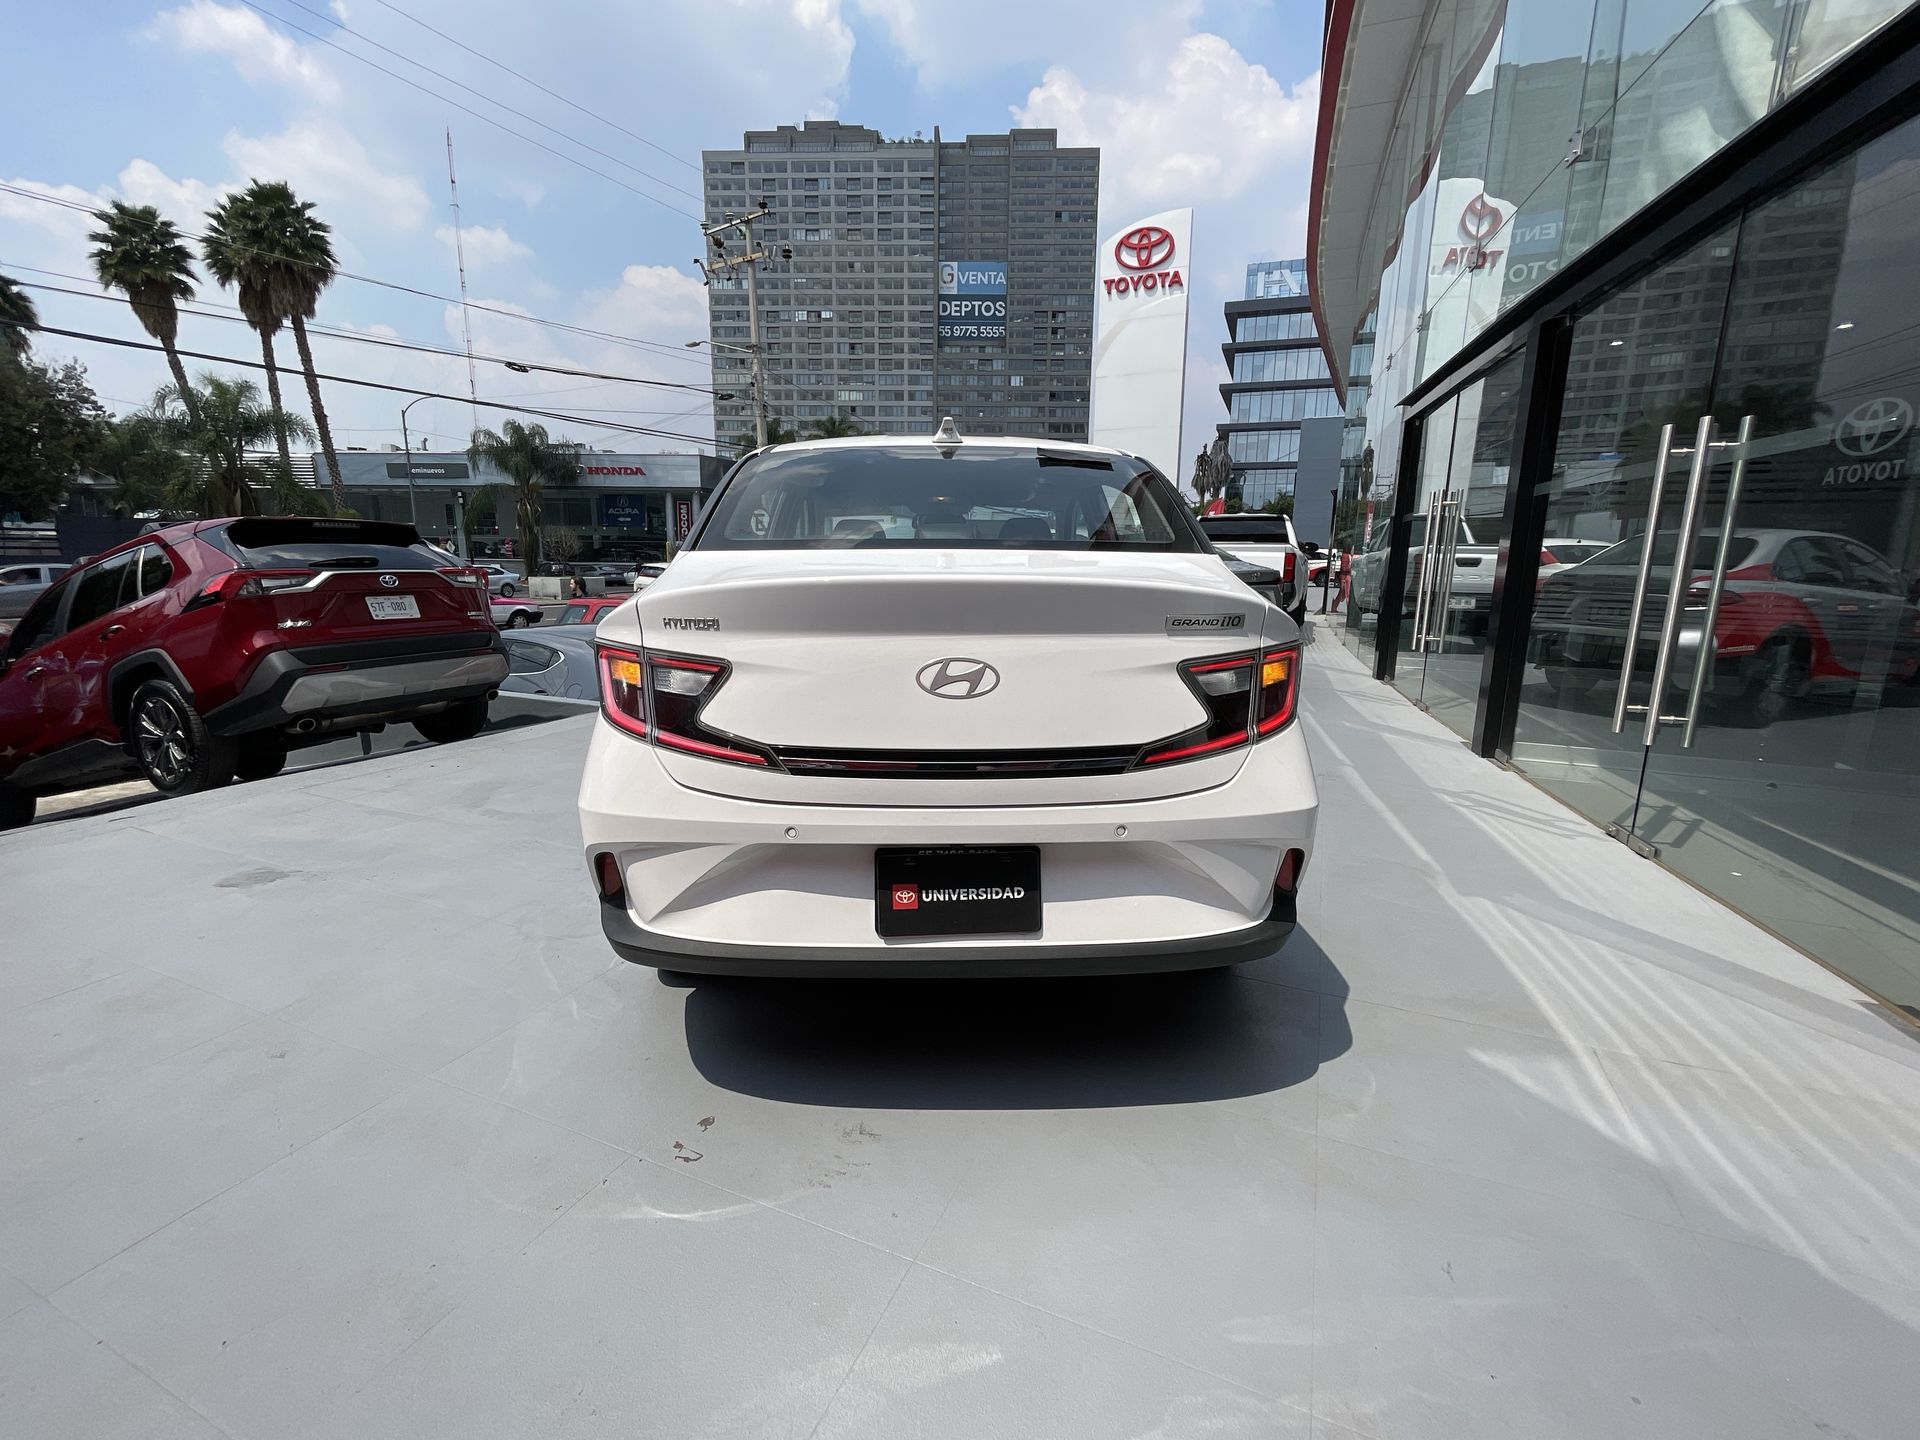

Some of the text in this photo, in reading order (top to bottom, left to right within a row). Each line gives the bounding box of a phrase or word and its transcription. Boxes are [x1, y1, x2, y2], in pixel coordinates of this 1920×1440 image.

[958, 271, 1006, 285] VENTA
[1103, 270, 1184, 295] TOYOTA
[939, 301, 1006, 317] DEPTOS
[939, 325, 1006, 337] 55 9775 5555
[586, 466, 646, 476] HONDA
[1171, 616, 1242, 627] GRAND i10
[922, 886, 1025, 902] UNIVERSIDAD
